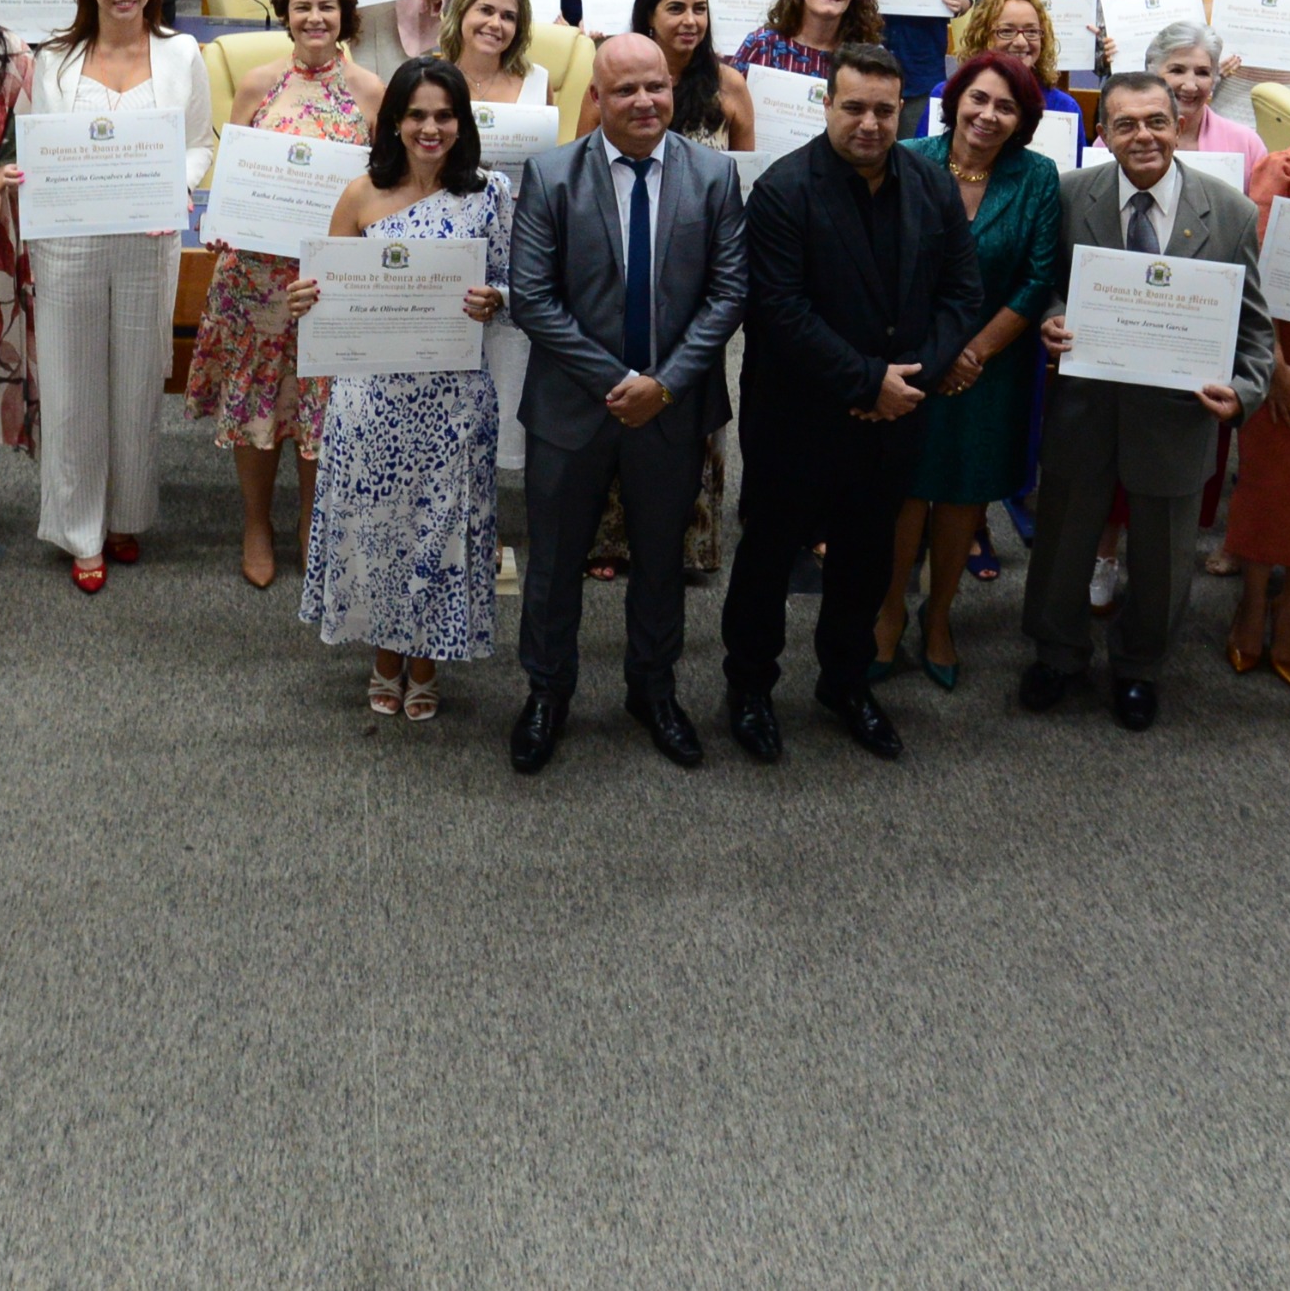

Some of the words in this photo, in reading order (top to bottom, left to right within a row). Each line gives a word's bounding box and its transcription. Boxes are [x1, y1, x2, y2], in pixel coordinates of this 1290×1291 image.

[40, 145, 76, 155] Diploma
[80, 144, 88, 152] de
[92, 143, 118, 152] Honra
[134, 141, 163, 150] Mérito
[237, 159, 272, 173] Diploma
[274, 165, 284, 174] de
[286, 167, 312, 179] Honra
[44, 175, 68, 183] Regina
[89, 172, 122, 181] Gonçalves
[135, 170, 160, 178] Almeida
[326, 271, 365, 281] Diploma
[369, 272, 379, 281] de
[383, 272, 412, 281] Honra
[430, 272, 461, 282] Mérito
[1092, 282, 1130, 295] Diploma
[1133, 287, 1141, 296] de
[1145, 288, 1172, 300] Honra
[1174, 293, 1185, 301] ao
[1189, 293, 1219, 306] Mérito
[1116, 317, 1140, 326] Vagner
